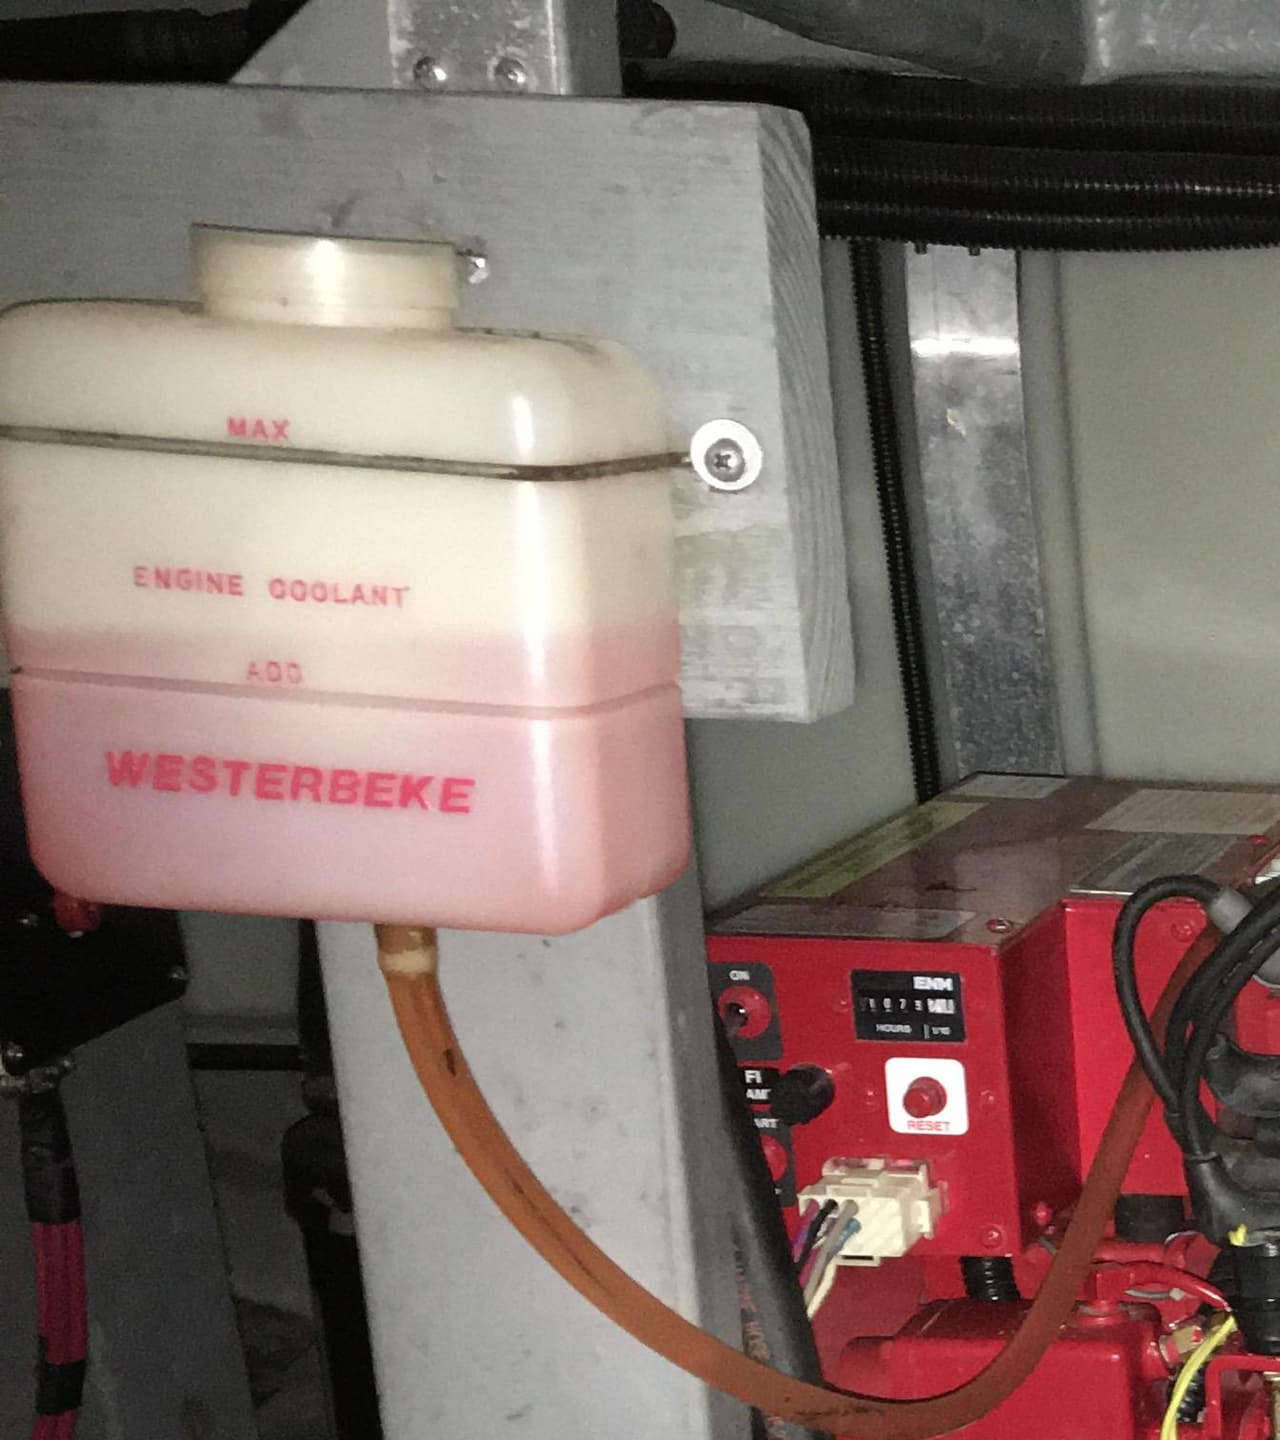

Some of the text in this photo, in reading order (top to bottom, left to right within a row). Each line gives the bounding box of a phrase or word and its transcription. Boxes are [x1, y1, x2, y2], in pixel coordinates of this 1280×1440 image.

[226, 416, 290, 441] MAX
[132, 565, 413, 610] ENGINE COOLANT
[246, 659, 304, 686] ADD
[105, 749, 477, 815] WESTERBEKE
[729, 969, 750, 981] ON
[906, 1120, 950, 1132] RESET
